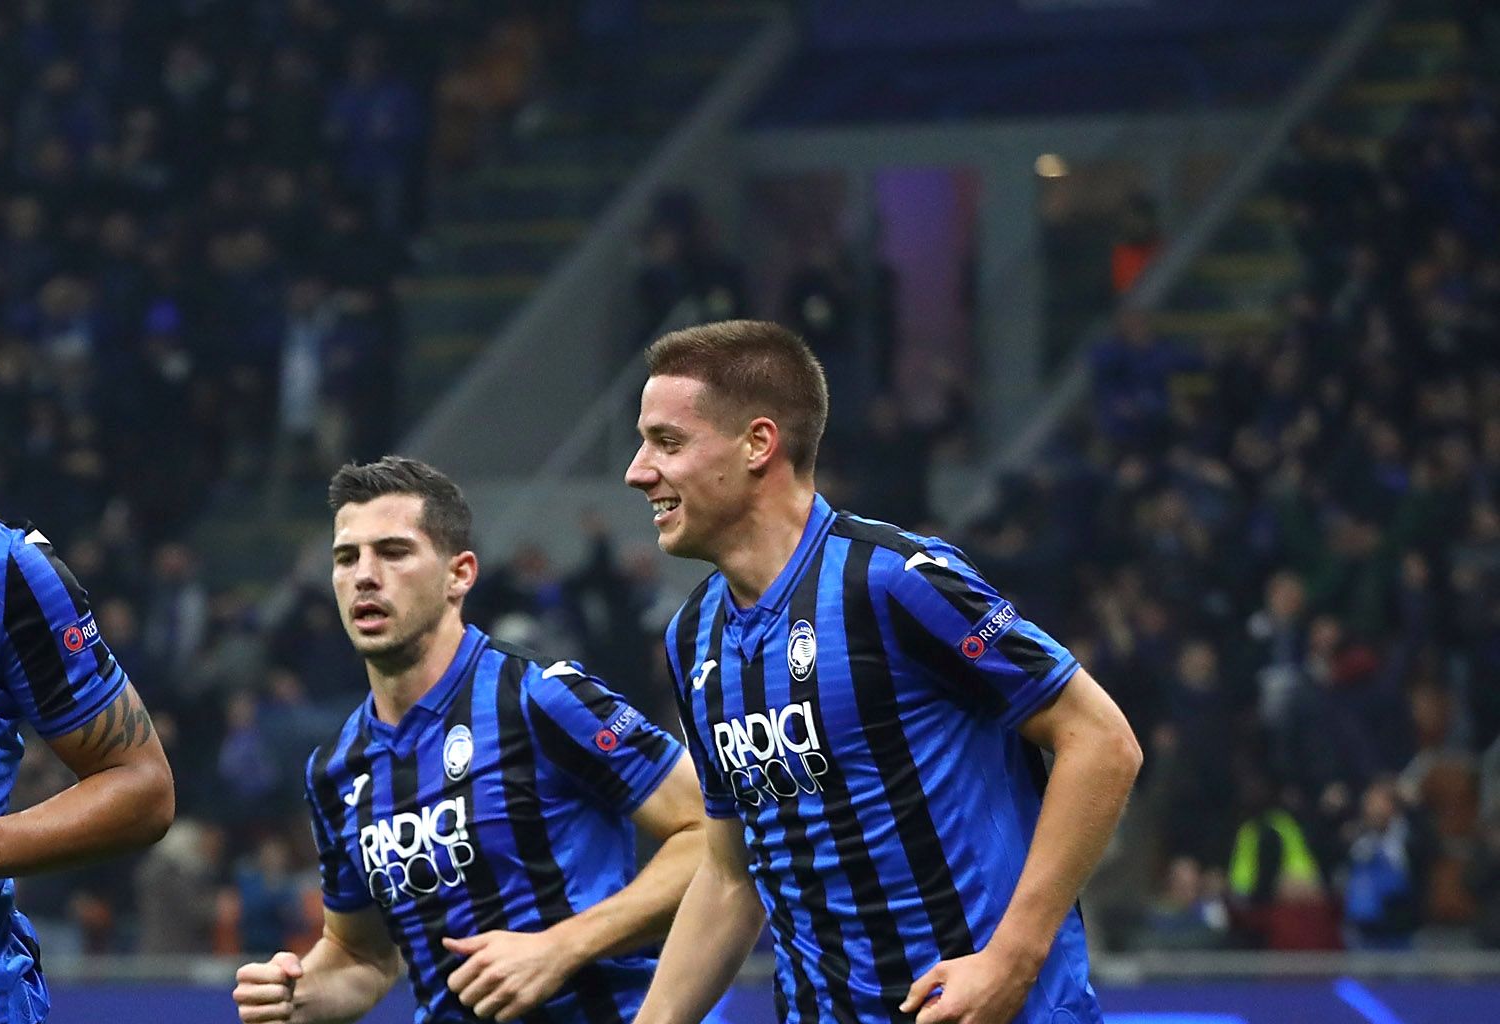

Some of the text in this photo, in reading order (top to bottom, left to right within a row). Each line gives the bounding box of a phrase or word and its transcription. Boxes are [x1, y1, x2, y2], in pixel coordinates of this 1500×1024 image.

[979, 605, 1015, 641] RESPECT
[713, 700, 821, 772] RADICI
[730, 752, 828, 806] GROUP
[359, 796, 469, 873] RADICI
[369, 842, 476, 907] GROUP
